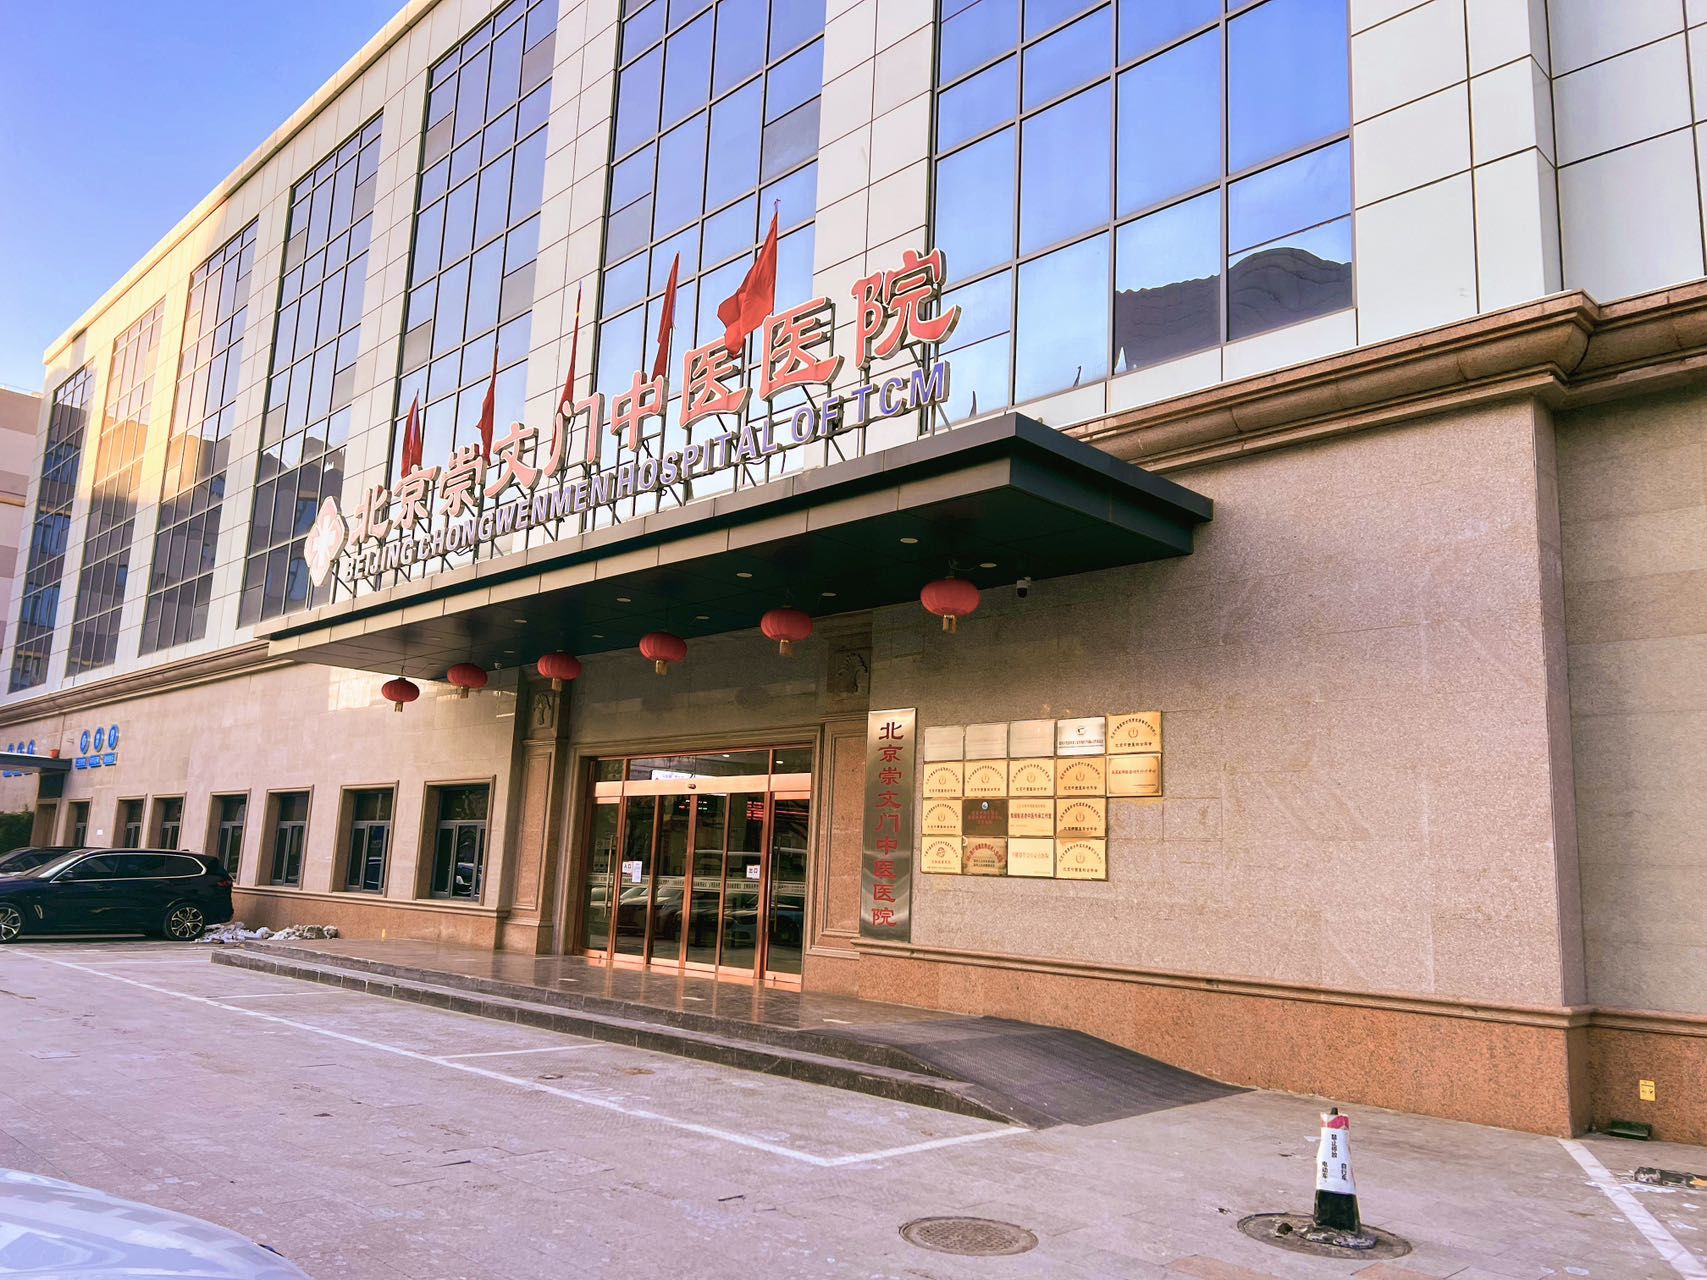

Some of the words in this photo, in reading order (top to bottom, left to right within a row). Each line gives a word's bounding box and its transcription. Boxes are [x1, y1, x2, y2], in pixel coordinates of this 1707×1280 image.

[344, 539, 415, 583] BEIJING
[416, 472, 615, 561] CHONGWENMEN
[615, 420, 781, 498] HOSPITAL
[791, 396, 843, 444] OF
[851, 360, 951, 422] TCM
[349, 247, 962, 548] 北京崇文门中医医院
[872, 722, 905, 928] 北京崇文门中医医院
